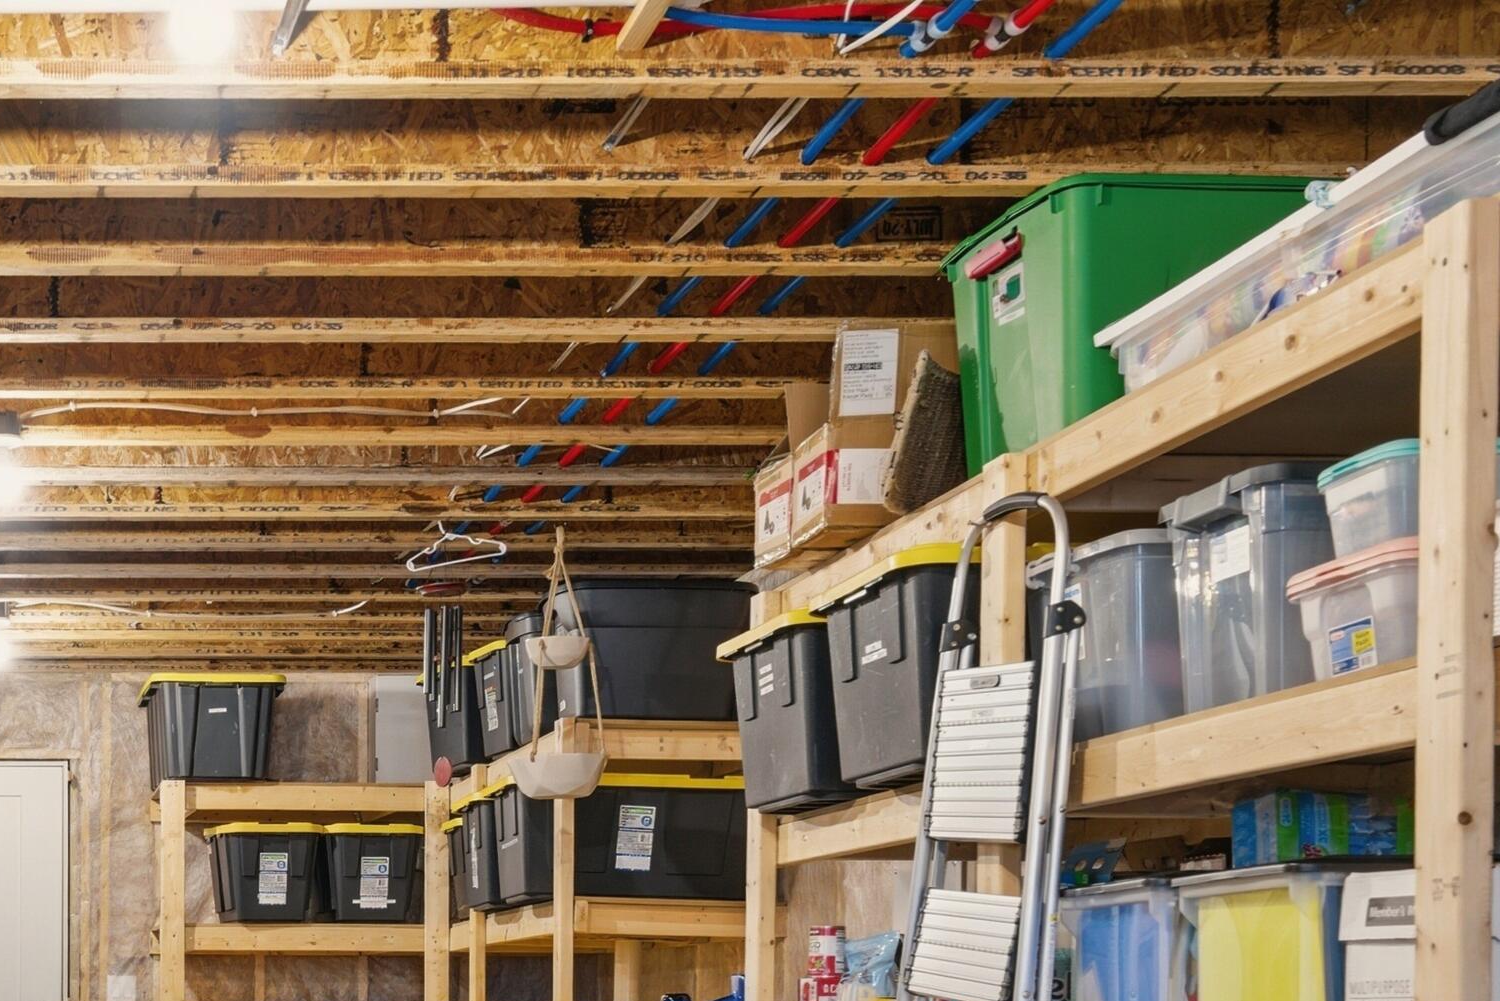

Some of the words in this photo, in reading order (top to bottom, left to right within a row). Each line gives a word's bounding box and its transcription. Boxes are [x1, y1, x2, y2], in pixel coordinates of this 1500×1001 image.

[499, 68, 542, 79] 210
[1069, 66, 1198, 78] CERTIFIED
[1208, 65, 1327, 78] SOURCING
[670, 250, 706, 263] 210
